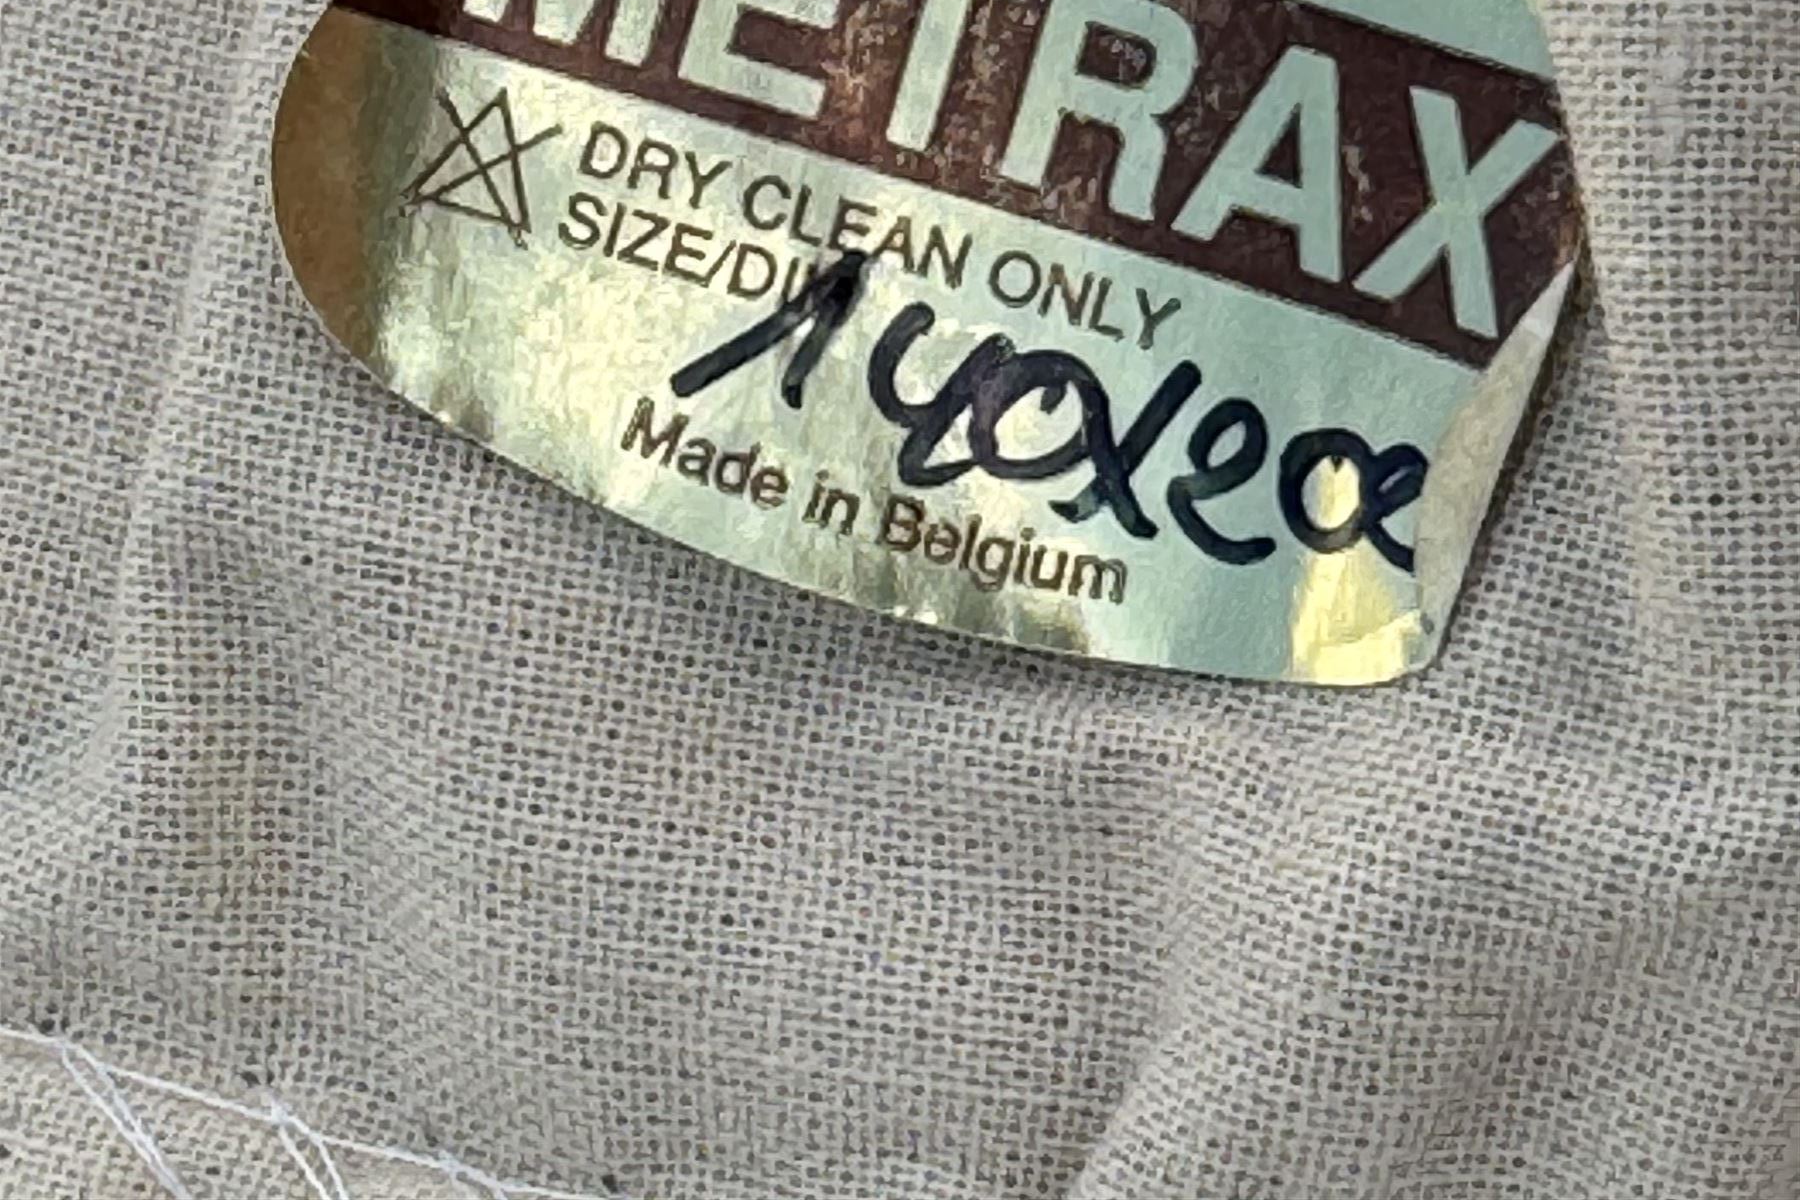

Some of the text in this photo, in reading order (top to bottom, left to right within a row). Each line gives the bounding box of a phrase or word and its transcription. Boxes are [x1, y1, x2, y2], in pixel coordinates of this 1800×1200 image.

[579, 121, 1181, 349] DRY CLEAN ONLY
[620, 395, 1129, 605] Made in Belgium
